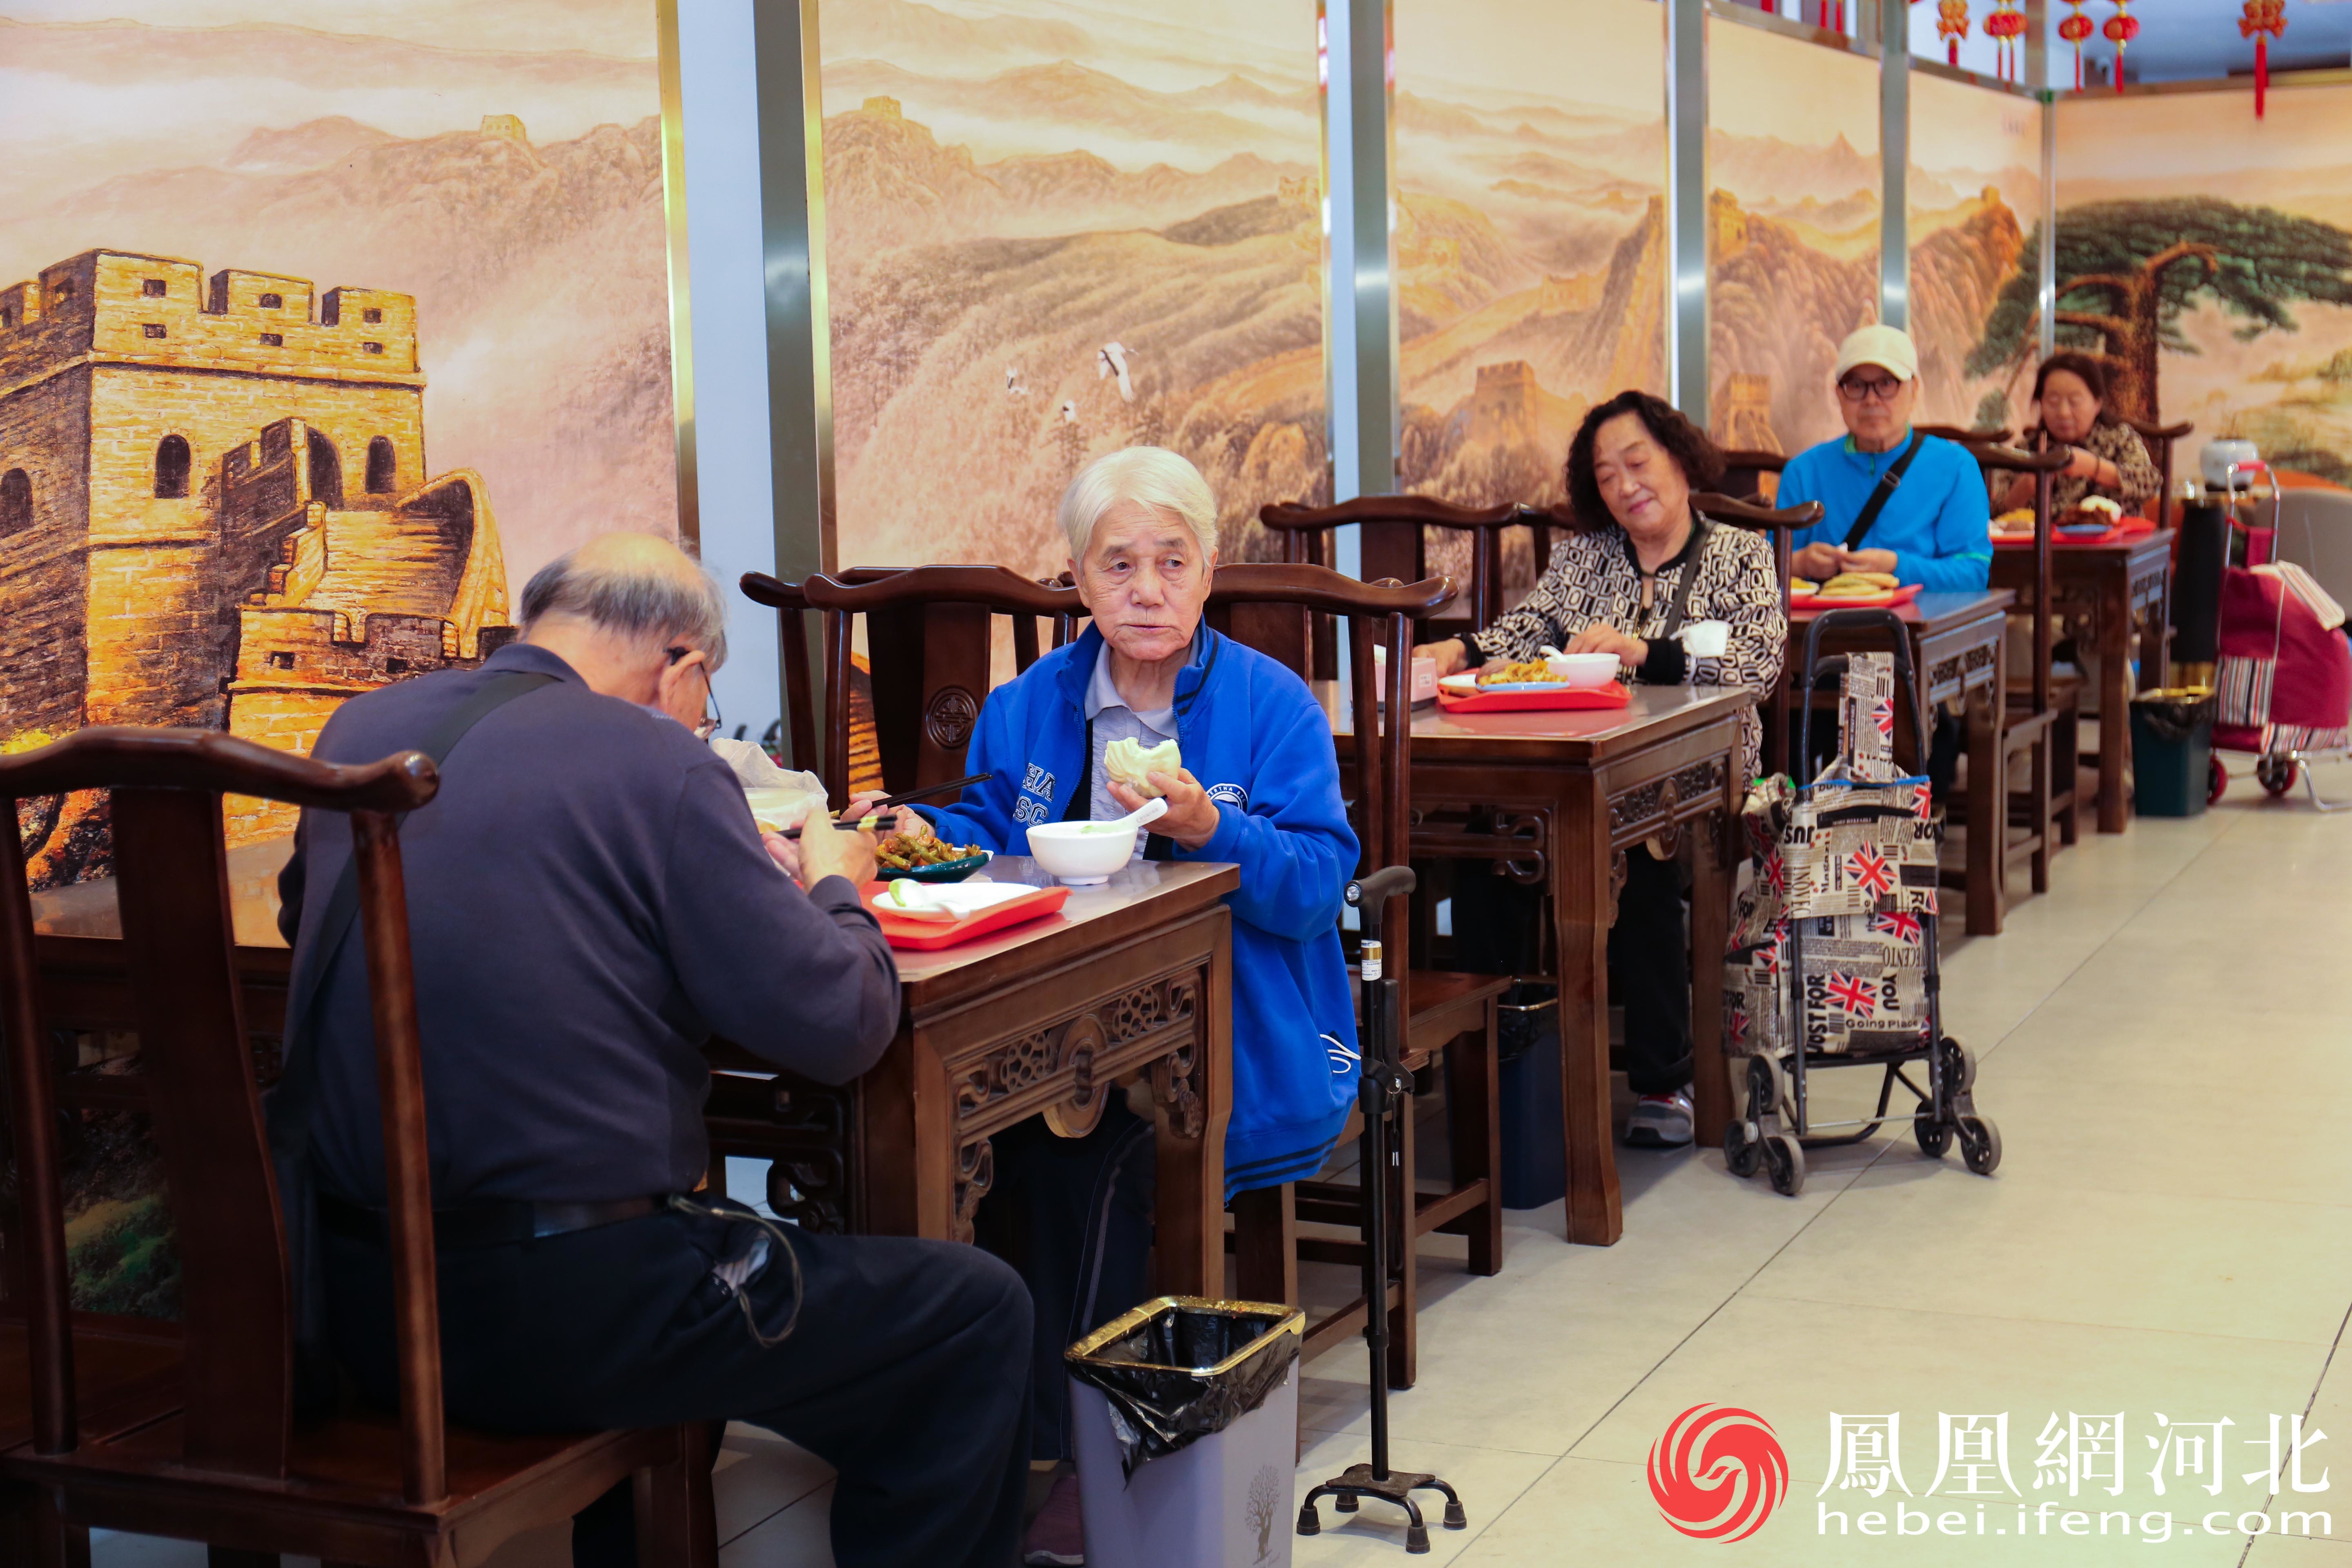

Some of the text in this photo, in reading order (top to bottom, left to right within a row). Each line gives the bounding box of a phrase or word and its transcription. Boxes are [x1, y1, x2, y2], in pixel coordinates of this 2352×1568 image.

[1236, 791, 1246, 803] BSC
[1806, 975, 1827, 1010] FOR
[1881, 973, 1901, 1011] YOU
[1846, 1018, 1886, 1029] Going
